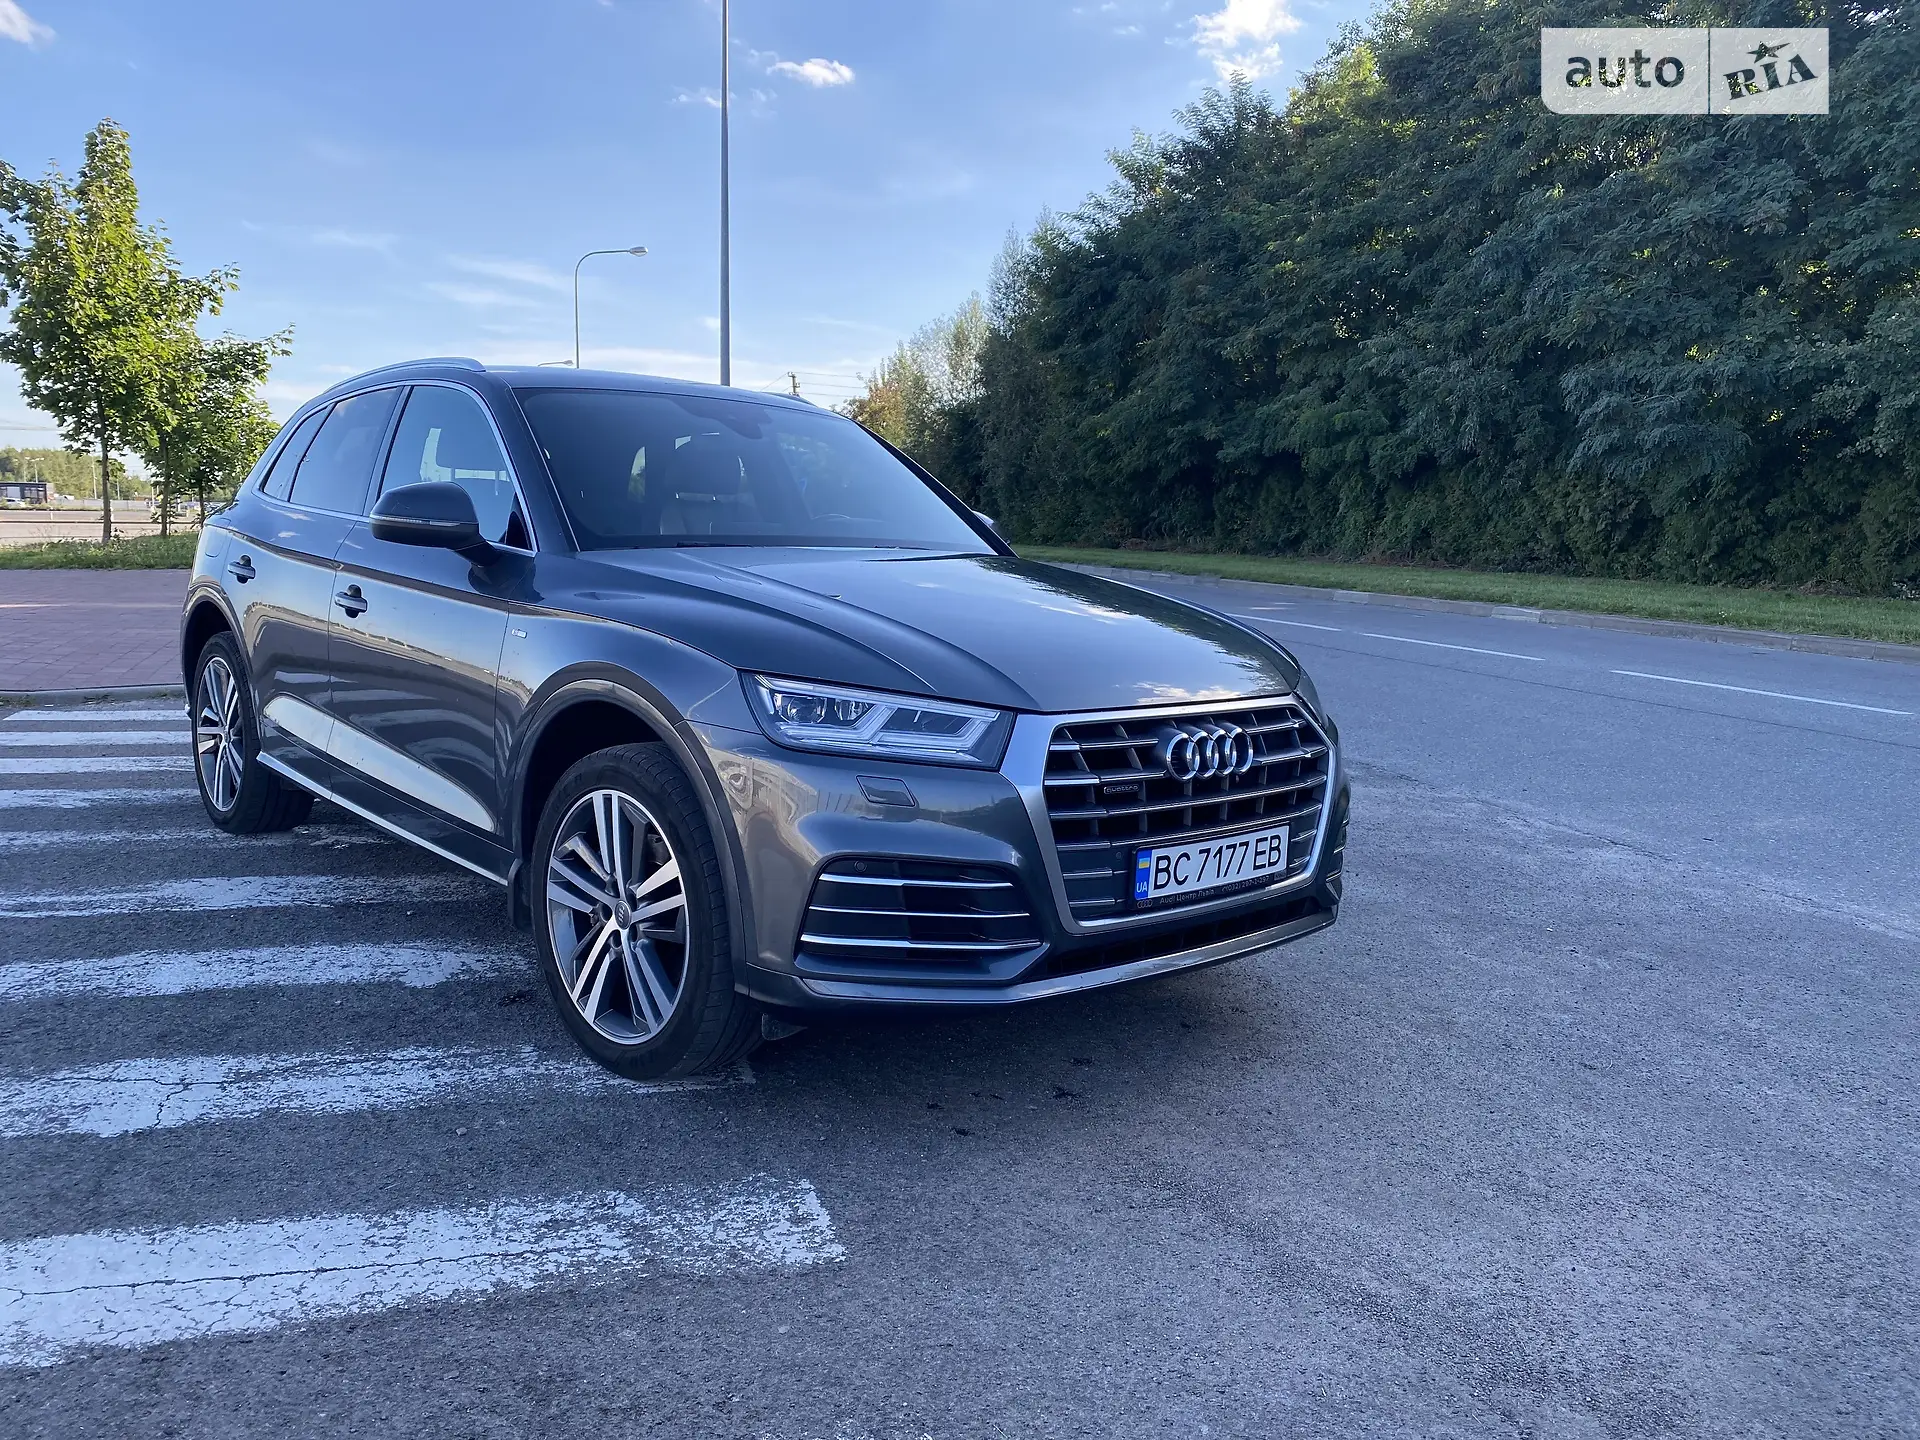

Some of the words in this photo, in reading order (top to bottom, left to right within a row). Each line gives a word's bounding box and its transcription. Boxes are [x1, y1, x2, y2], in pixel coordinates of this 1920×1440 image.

[1105, 784, 1139, 793] quattro
[1153, 851, 1191, 890] BC
[1195, 840, 1250, 882] 7177
[1252, 834, 1282, 871] EB
[1136, 881, 1148, 893] UA
